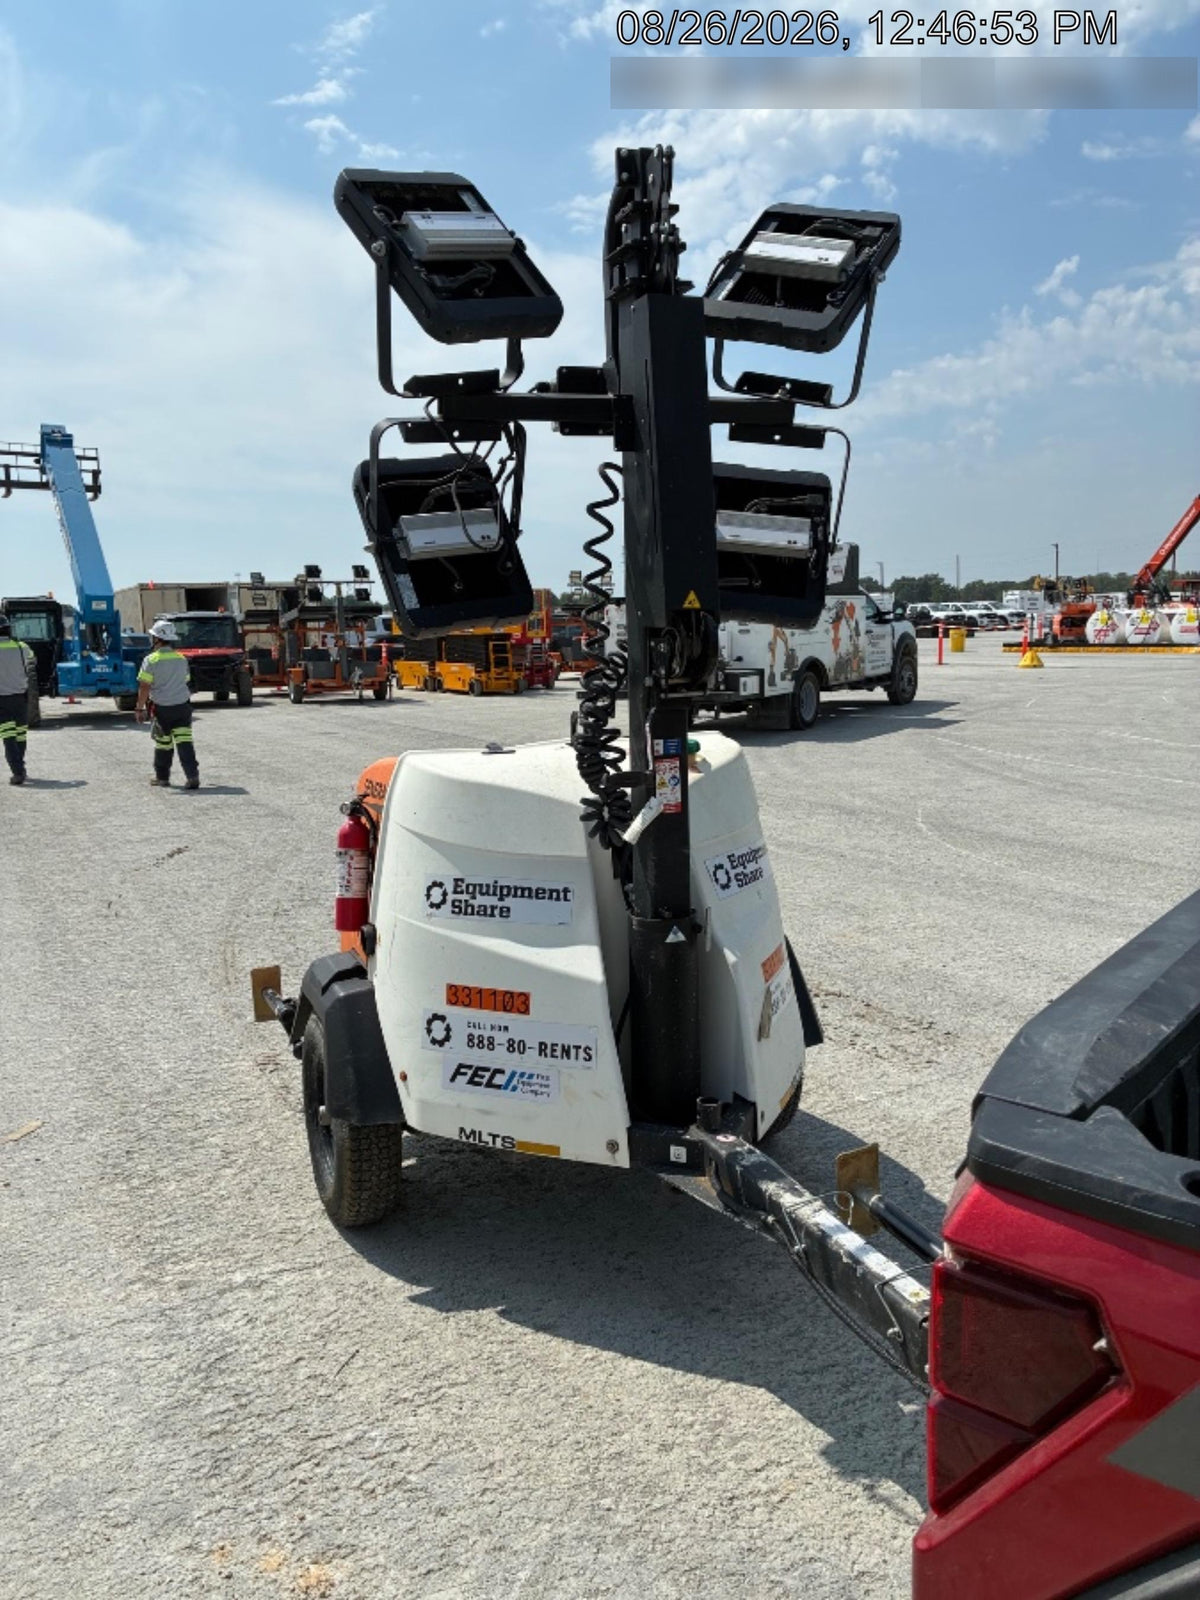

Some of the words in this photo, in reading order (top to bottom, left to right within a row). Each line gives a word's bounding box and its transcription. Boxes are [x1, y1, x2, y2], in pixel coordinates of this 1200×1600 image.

[452, 878, 571, 902] Equipment
[451, 899, 511, 918] Share
[448, 984, 529, 1014] 331103
[466, 1033, 593, 1062] 888-80-RENTS
[449, 1062, 506, 1090] FEC
[459, 1126, 516, 1150] MLTS
